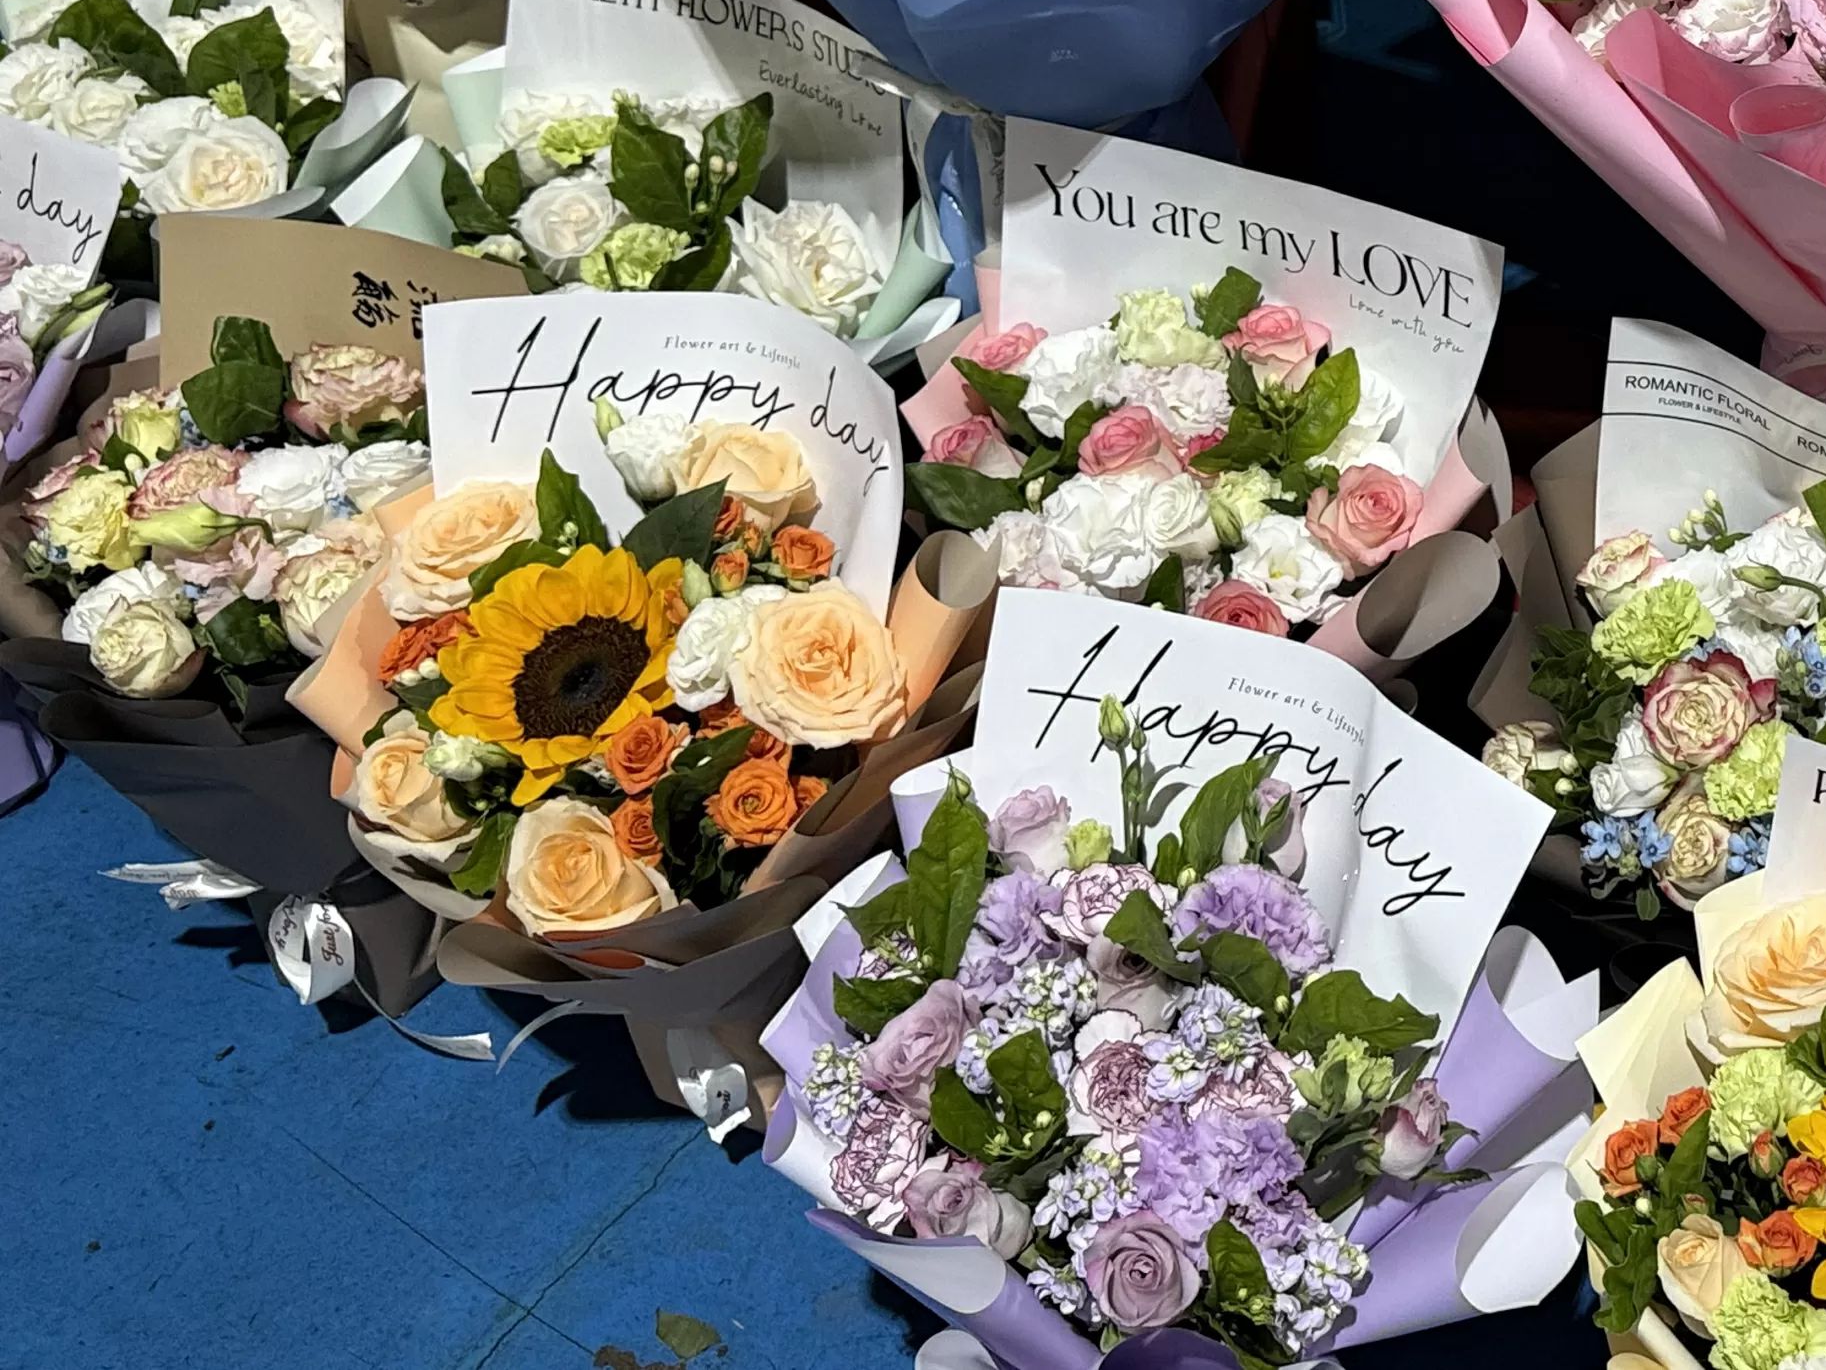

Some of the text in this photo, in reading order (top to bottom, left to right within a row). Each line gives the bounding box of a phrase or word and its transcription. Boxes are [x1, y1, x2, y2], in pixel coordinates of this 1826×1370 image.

[760, 60, 843, 116] Everlasting
[812, 30, 886, 96] STU
[17, 152, 102, 264] day
[1034, 163, 1136, 229] You
[1152, 201, 1225, 245] are
[1239, 218, 1316, 273] my
[1330, 230, 1475, 328] LOVE
[664, 335, 715, 351] Flower
[719, 341, 740, 352] art
[745, 342, 756, 353] &
[1432, 335, 1465, 353] you
[471, 316, 889, 497] Happy day
[1625, 375, 1772, 431] ROMANTIC FLORAL
[1658, 397, 1693, 409] FLOWER
[1702, 406, 1742, 426] LIFESTYLE
[1228, 677, 1279, 701] Flower
[1284, 694, 1305, 709] art
[1311, 700, 1323, 714] &
[1027, 624, 1465, 916] Happy day
